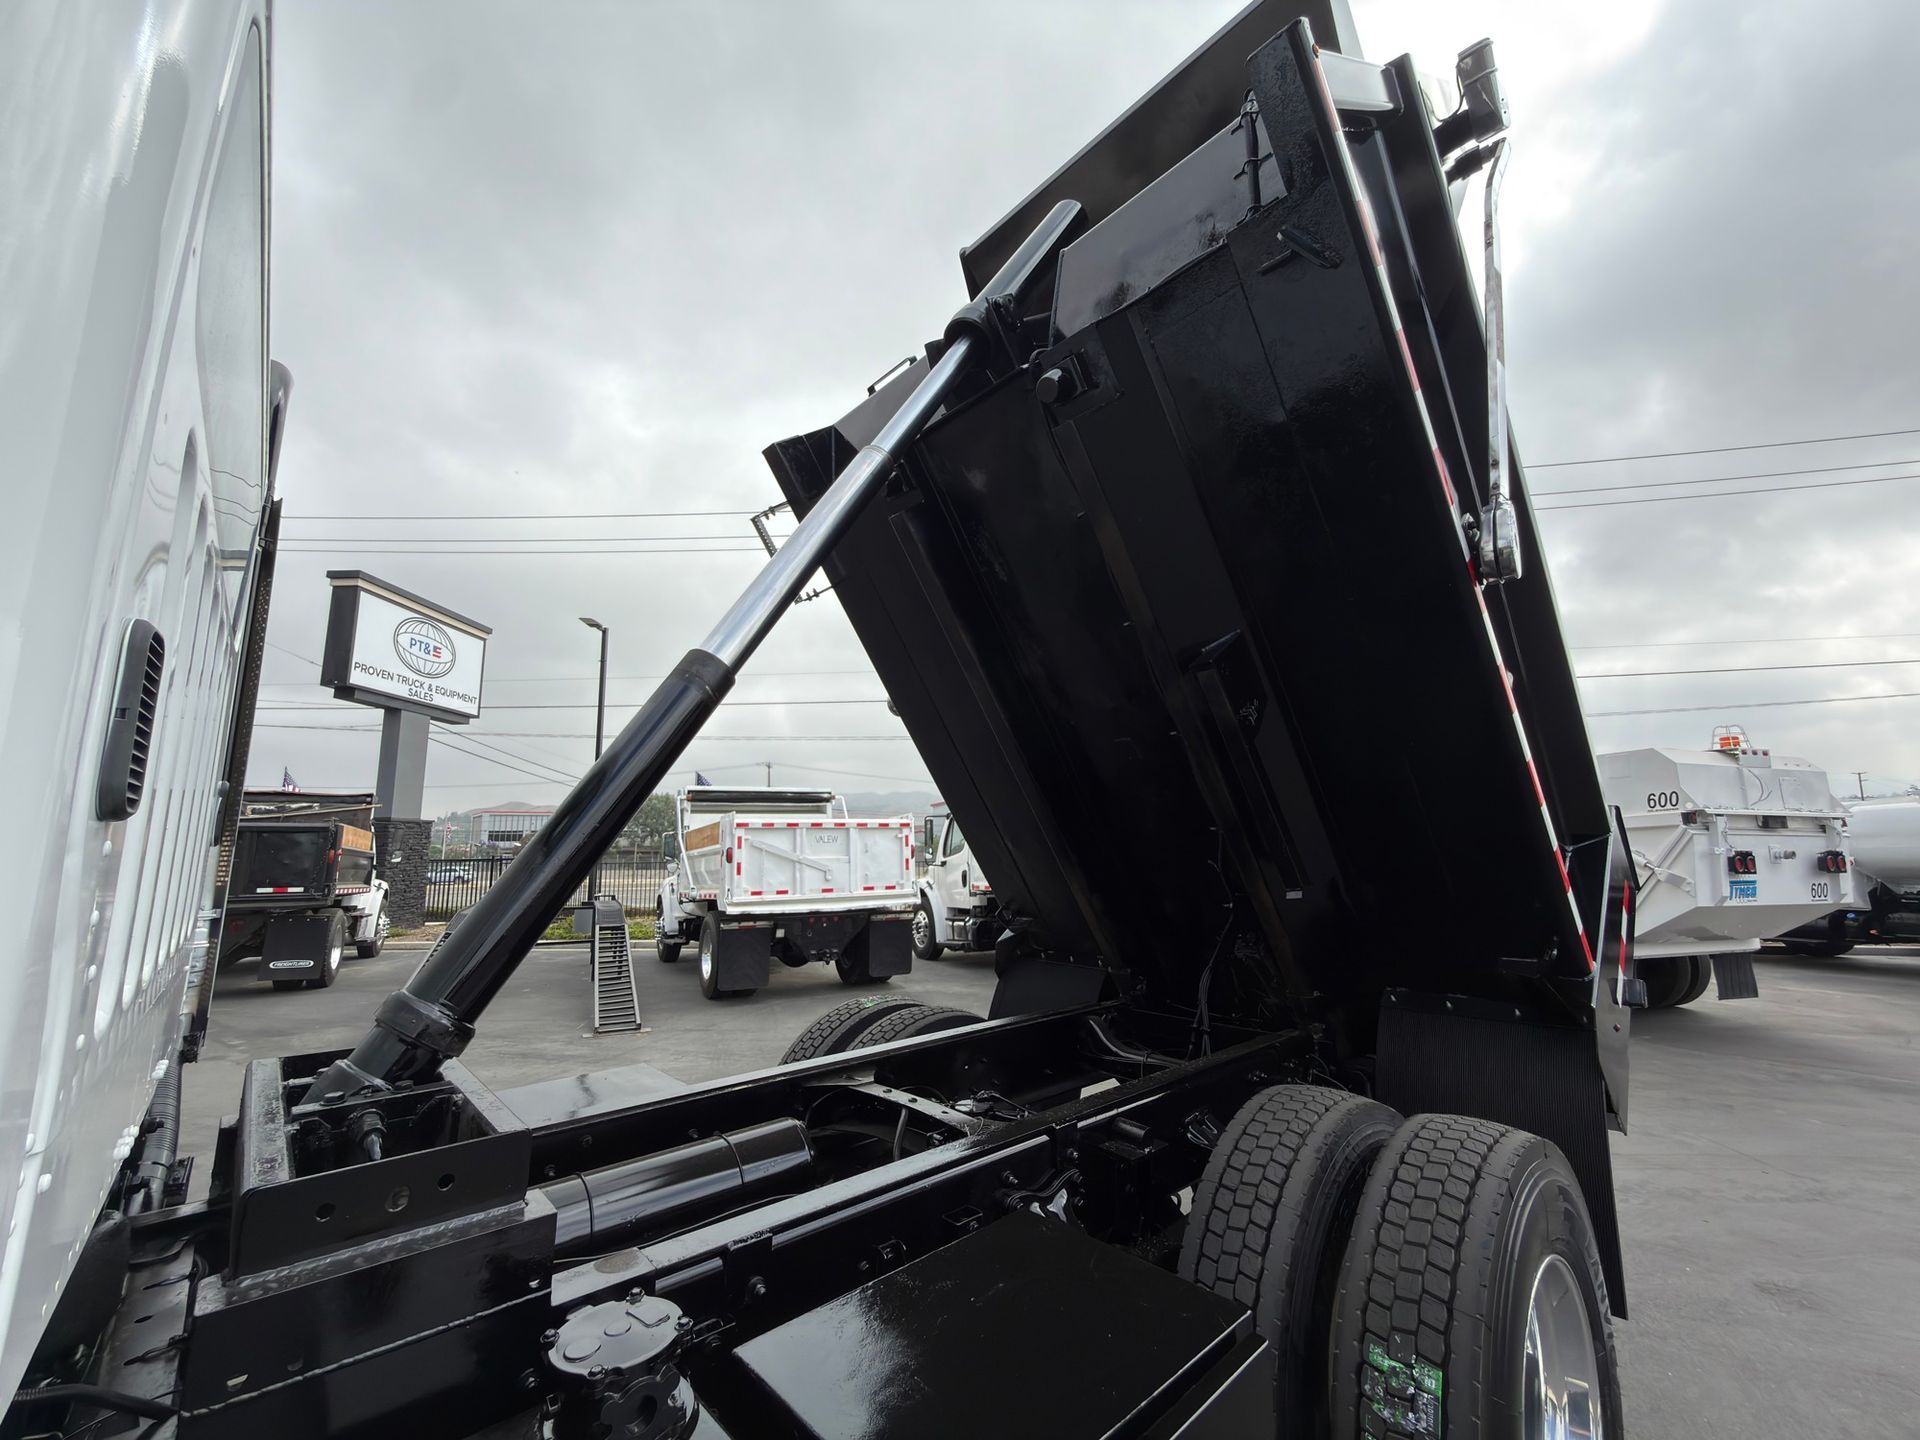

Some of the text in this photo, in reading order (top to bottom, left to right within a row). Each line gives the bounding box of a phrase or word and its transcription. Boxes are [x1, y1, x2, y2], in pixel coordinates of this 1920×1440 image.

[409, 637, 442, 659] PT&E
[353, 662, 477, 704] PROVEN TRUCK & EQUIPMENT
[408, 688, 434, 702] SALES
[1647, 791, 1679, 809] 600
[815, 834, 839, 844] VALEW
[1811, 883, 1829, 898] 600
